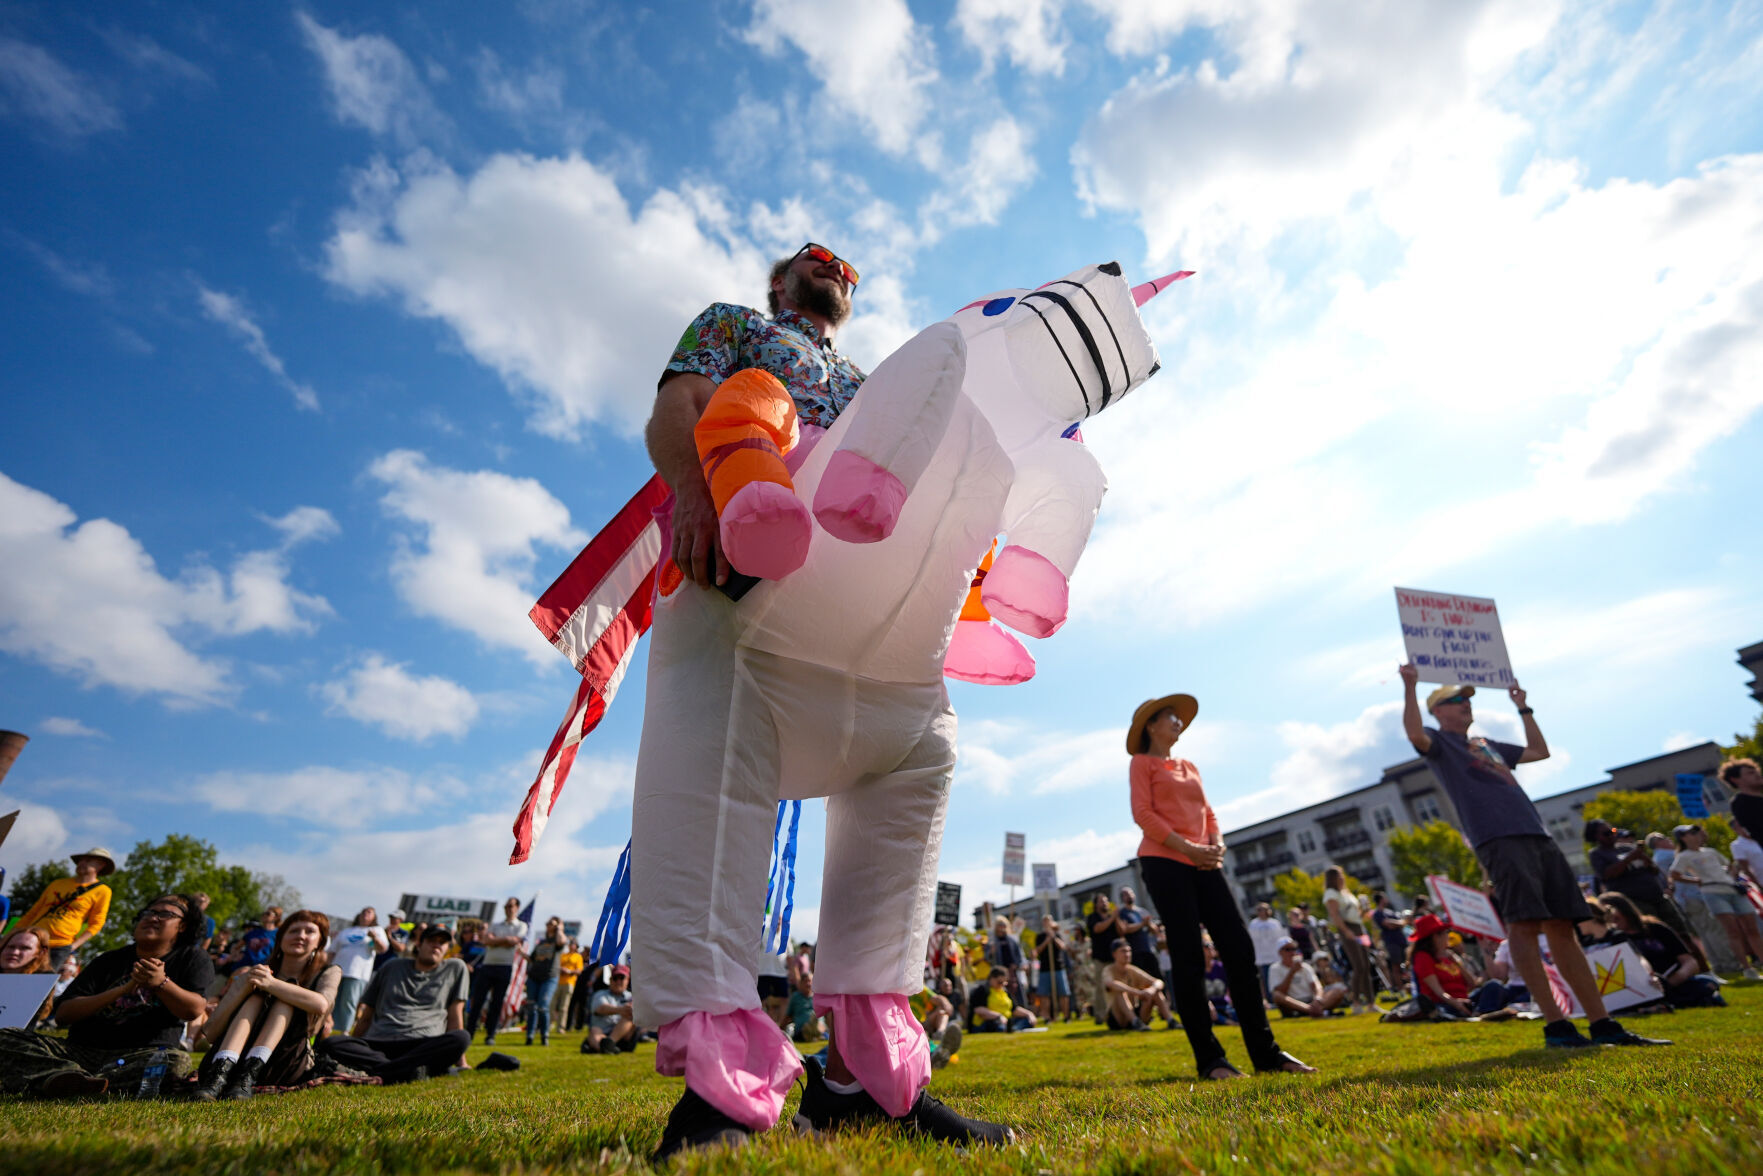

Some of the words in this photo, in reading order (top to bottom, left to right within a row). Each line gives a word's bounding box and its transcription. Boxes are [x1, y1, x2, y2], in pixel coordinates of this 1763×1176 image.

[1433, 627, 1455, 639] GIVE
[1475, 631, 1492, 642] THE
[1442, 641, 1477, 654] FIGHT
[427, 897, 471, 911] UAB
